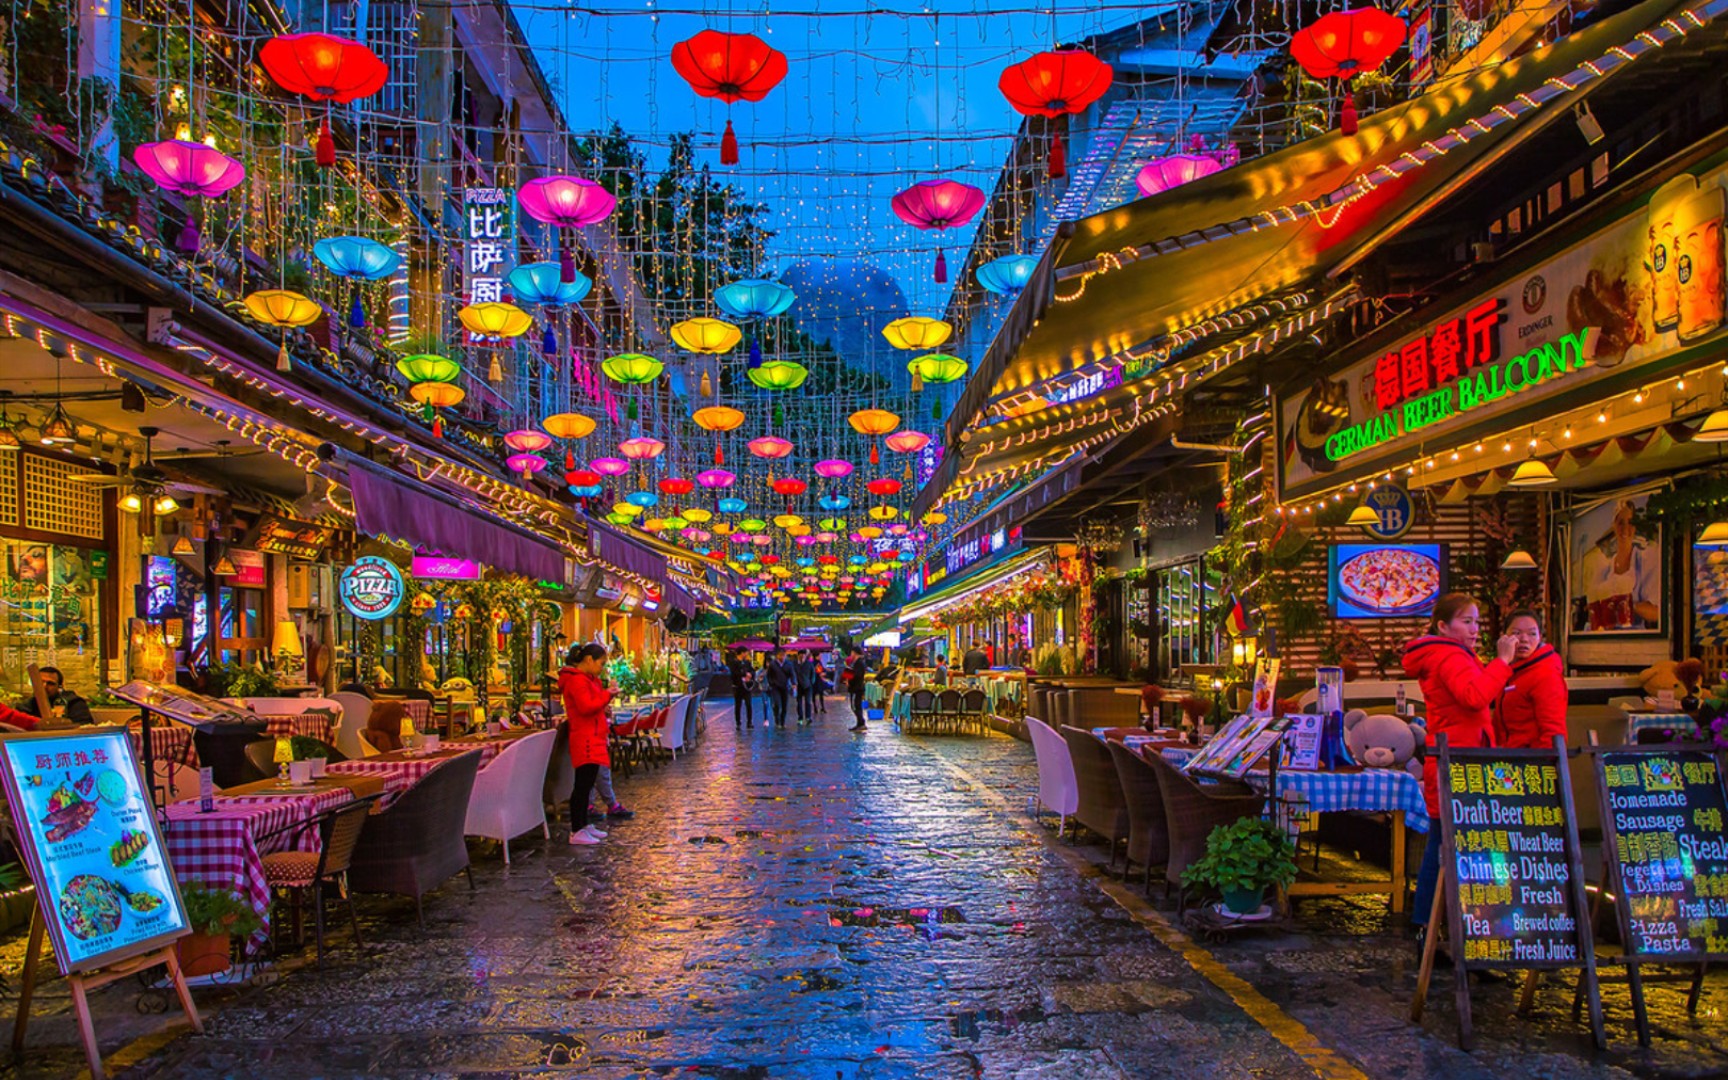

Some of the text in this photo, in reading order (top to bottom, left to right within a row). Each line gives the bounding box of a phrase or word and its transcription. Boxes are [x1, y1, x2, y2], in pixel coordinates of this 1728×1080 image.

[465, 187, 507, 204] PIZZA
[469, 206, 504, 342] 比萨厨
[1518, 314, 1553, 339] ERDINGER
[1374, 297, 1499, 411] 德国餐厅
[1325, 326, 1589, 461] GERMAN BEER BALCONY
[344, 576, 400, 597] PIZZA
[35, 748, 110, 770] 厨师推荐
[1449, 763, 1558, 795] 德国 餐厅
[1682, 761, 1716, 785] 餐厅
[1451, 799, 1523, 824] Draft Beer
[1616, 812, 1685, 832] Sausage
[1508, 832, 1564, 852] Wheat Beer
[1457, 856, 1569, 880] Chinese Dishes
[1520, 885, 1564, 904] Fresh
[1637, 879, 1685, 893] Dishes
[1679, 898, 1708, 919] Fresh
[1709, 898, 1728, 918] Sal
[1463, 913, 1491, 935] Tea
[1512, 912, 1576, 931] Brewed coffee
[1514, 939, 1577, 960] Fresh Juice
[1642, 935, 1692, 953] Pasta
